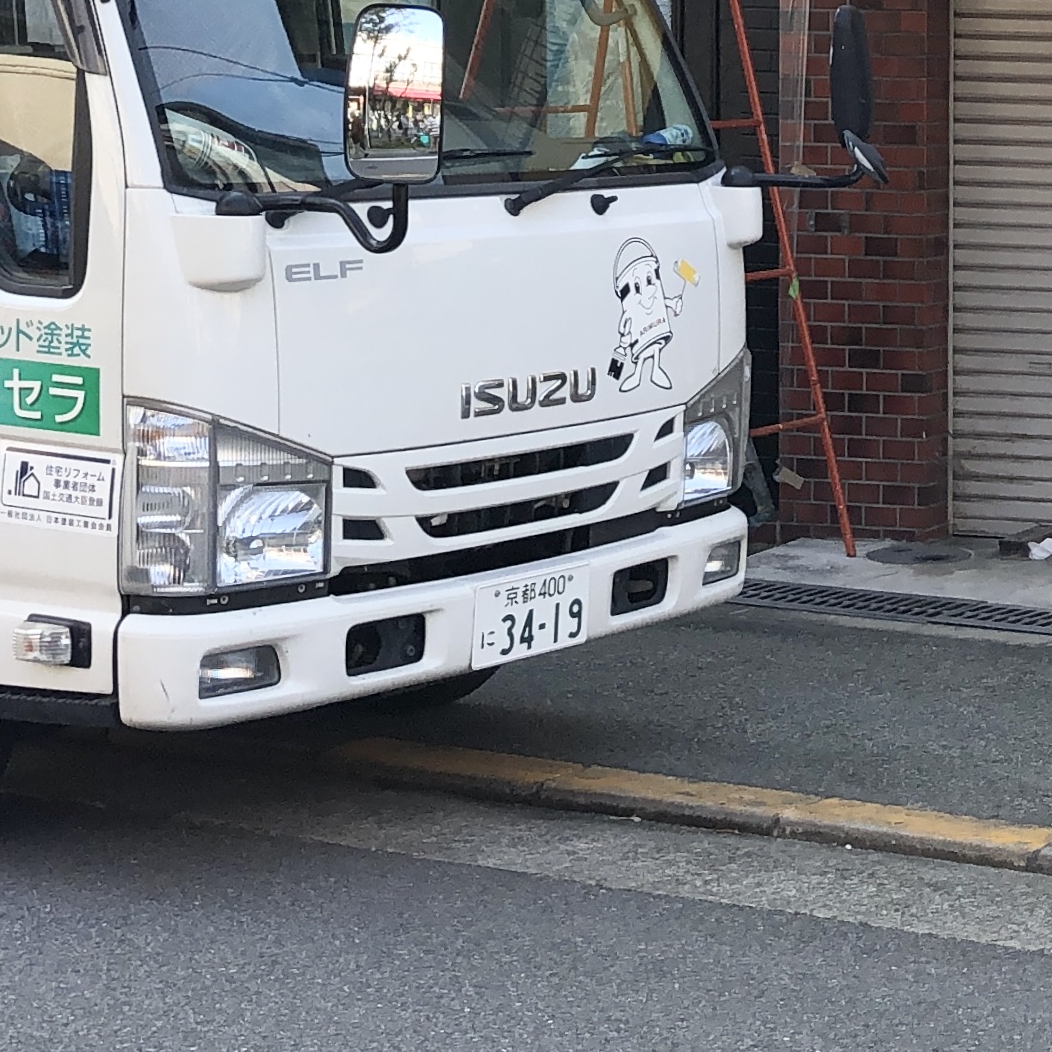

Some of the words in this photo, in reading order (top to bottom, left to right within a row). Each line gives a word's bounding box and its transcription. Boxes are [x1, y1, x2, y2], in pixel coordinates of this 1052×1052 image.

[285, 259, 364, 283] ELF
[459, 365, 598, 420] ISUZU
[45, 464, 106, 483] 住宅リフォーム
[52, 478, 97, 494] 事業者団体
[480, 630, 496, 650] に
[499, 597, 584, 656] 34-19
